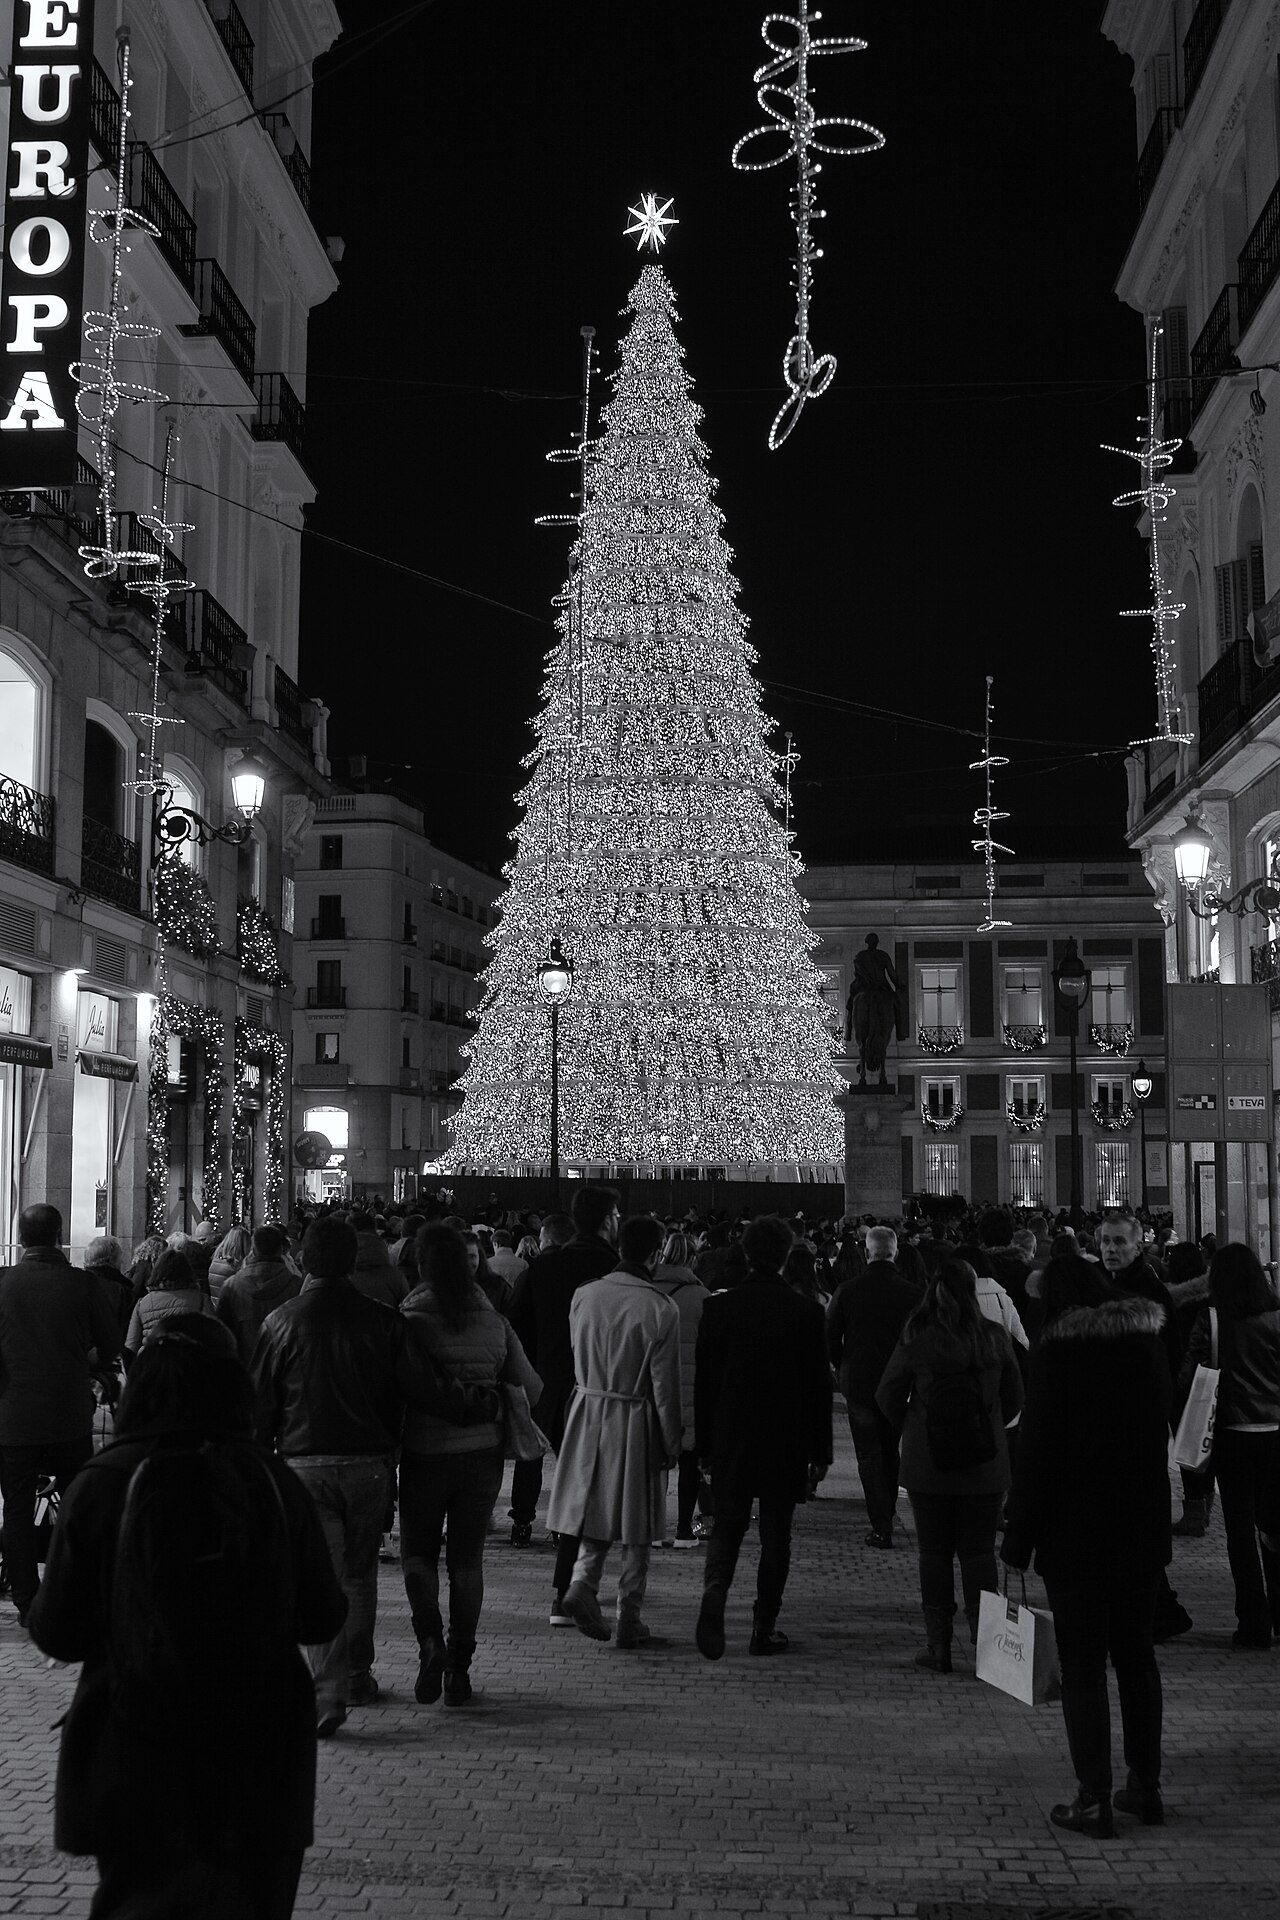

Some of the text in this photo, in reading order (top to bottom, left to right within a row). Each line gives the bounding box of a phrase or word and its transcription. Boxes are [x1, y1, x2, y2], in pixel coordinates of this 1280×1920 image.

[0, 0, 81, 430] EUROPA
[0, 986, 13, 1015] lia
[85, 1004, 105, 1046] Julia
[1239, 1098, 1264, 1107] TEVA
